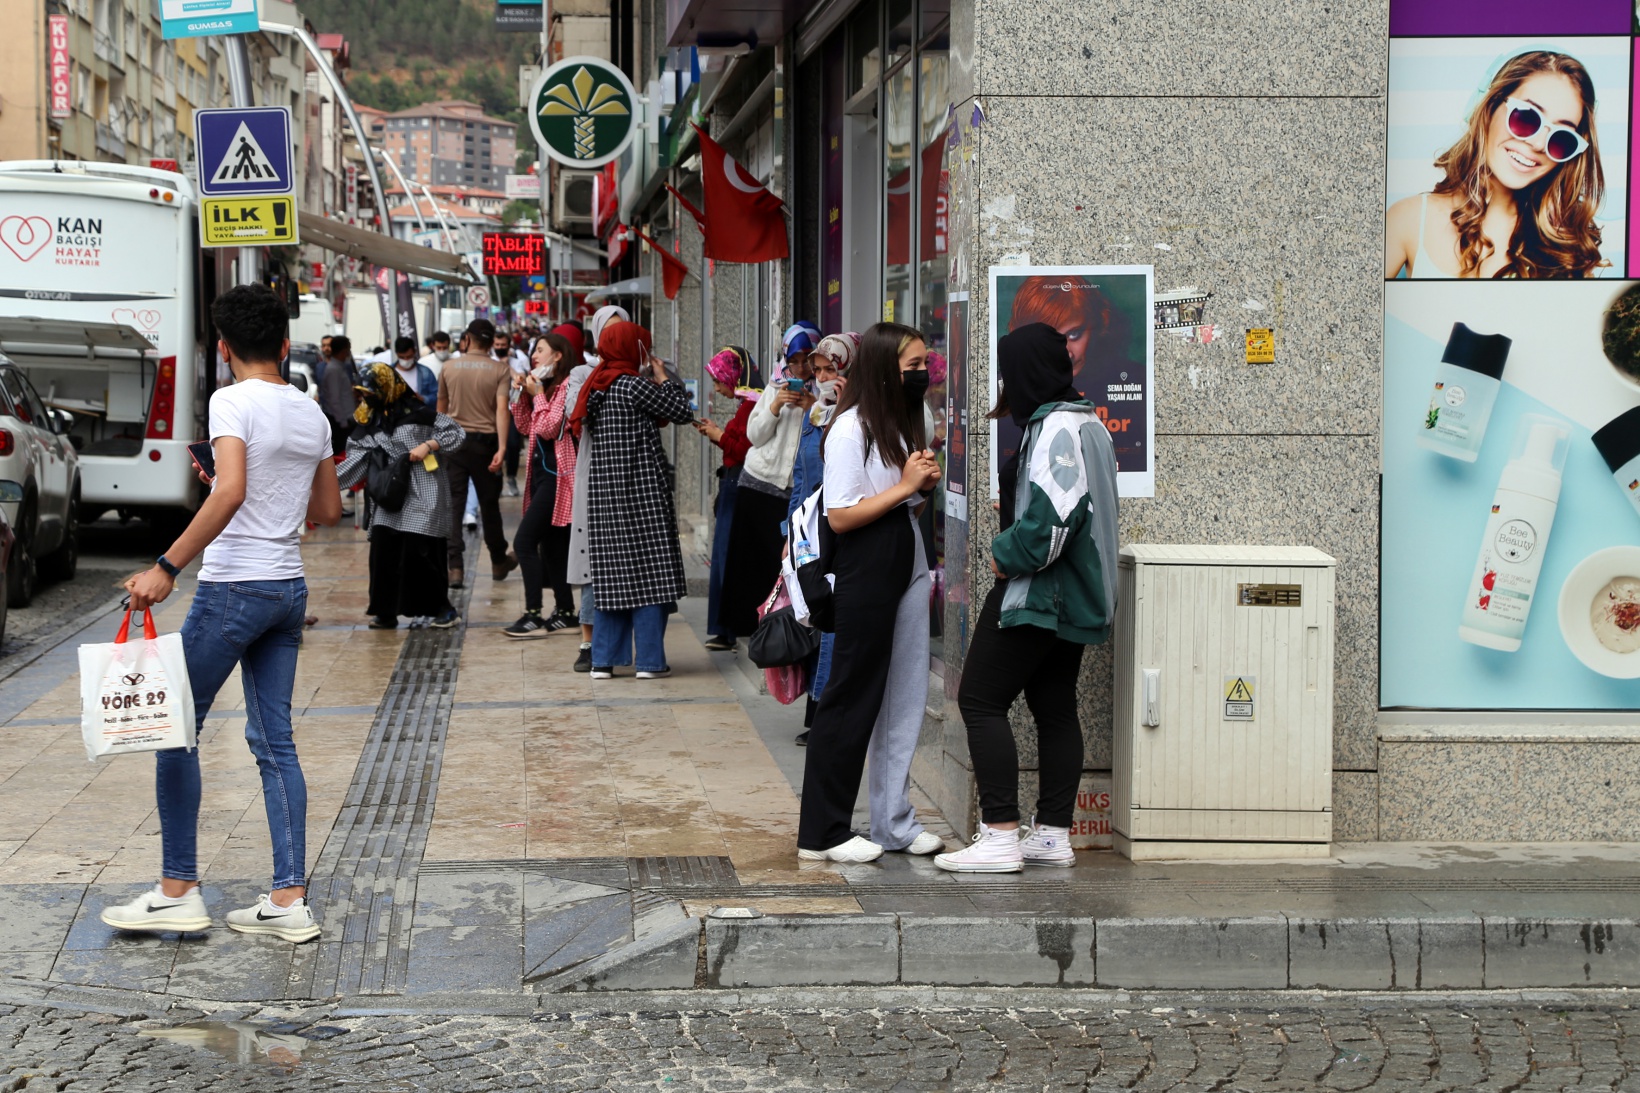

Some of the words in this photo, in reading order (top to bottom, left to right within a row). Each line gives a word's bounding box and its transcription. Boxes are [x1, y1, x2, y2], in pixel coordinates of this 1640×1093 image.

[53, 22, 68, 108] KUAFÖR
[213, 205, 261, 223] İLK
[57, 217, 102, 234] KAN
[56, 234, 102, 247] BAĞIŞI
[483, 237, 544, 251] TABLET
[55, 247, 100, 258] HAYAT
[55, 258, 100, 266] KURTARIR
[484, 255, 541, 271] TAMİRİ
[1107, 384, 1122, 392] SEMA
[1124, 383, 1142, 392] DOĞAN
[1107, 393, 1126, 402] YAŞAM
[1127, 393, 1142, 401] ALANI
[1509, 526, 1528, 538] Bee
[1499, 533, 1534, 551] Beauty
[101, 692, 140, 709] YÖRE
[146, 691, 166, 705] 29
[1077, 790, 1110, 809] ÜKS
[1069, 814, 1113, 836] GERİL
